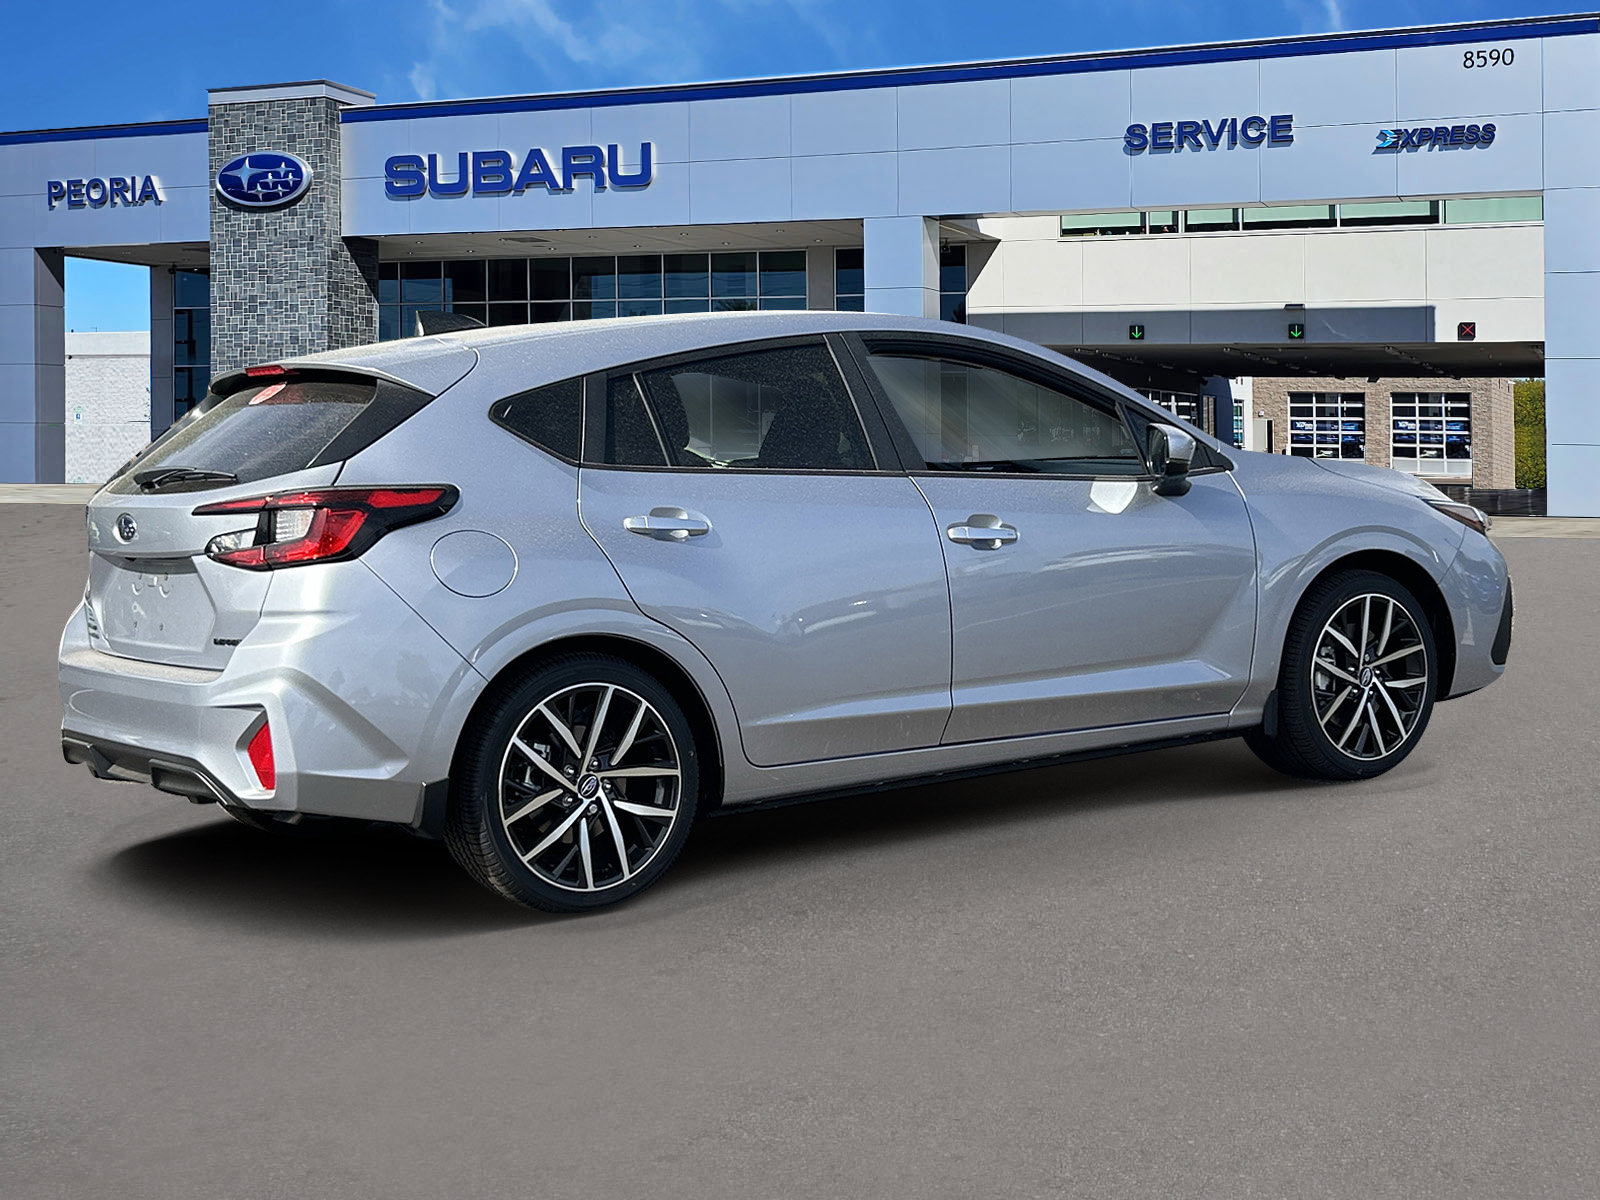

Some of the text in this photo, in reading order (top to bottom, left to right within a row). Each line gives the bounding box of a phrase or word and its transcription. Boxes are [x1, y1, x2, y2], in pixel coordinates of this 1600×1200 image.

[1463, 48, 1515, 69] 8590
[1124, 115, 1295, 151] SERVICE
[1376, 123, 1497, 149] EXPRESS
[384, 141, 653, 198] SUBARU
[47, 174, 162, 208] PEORIA
